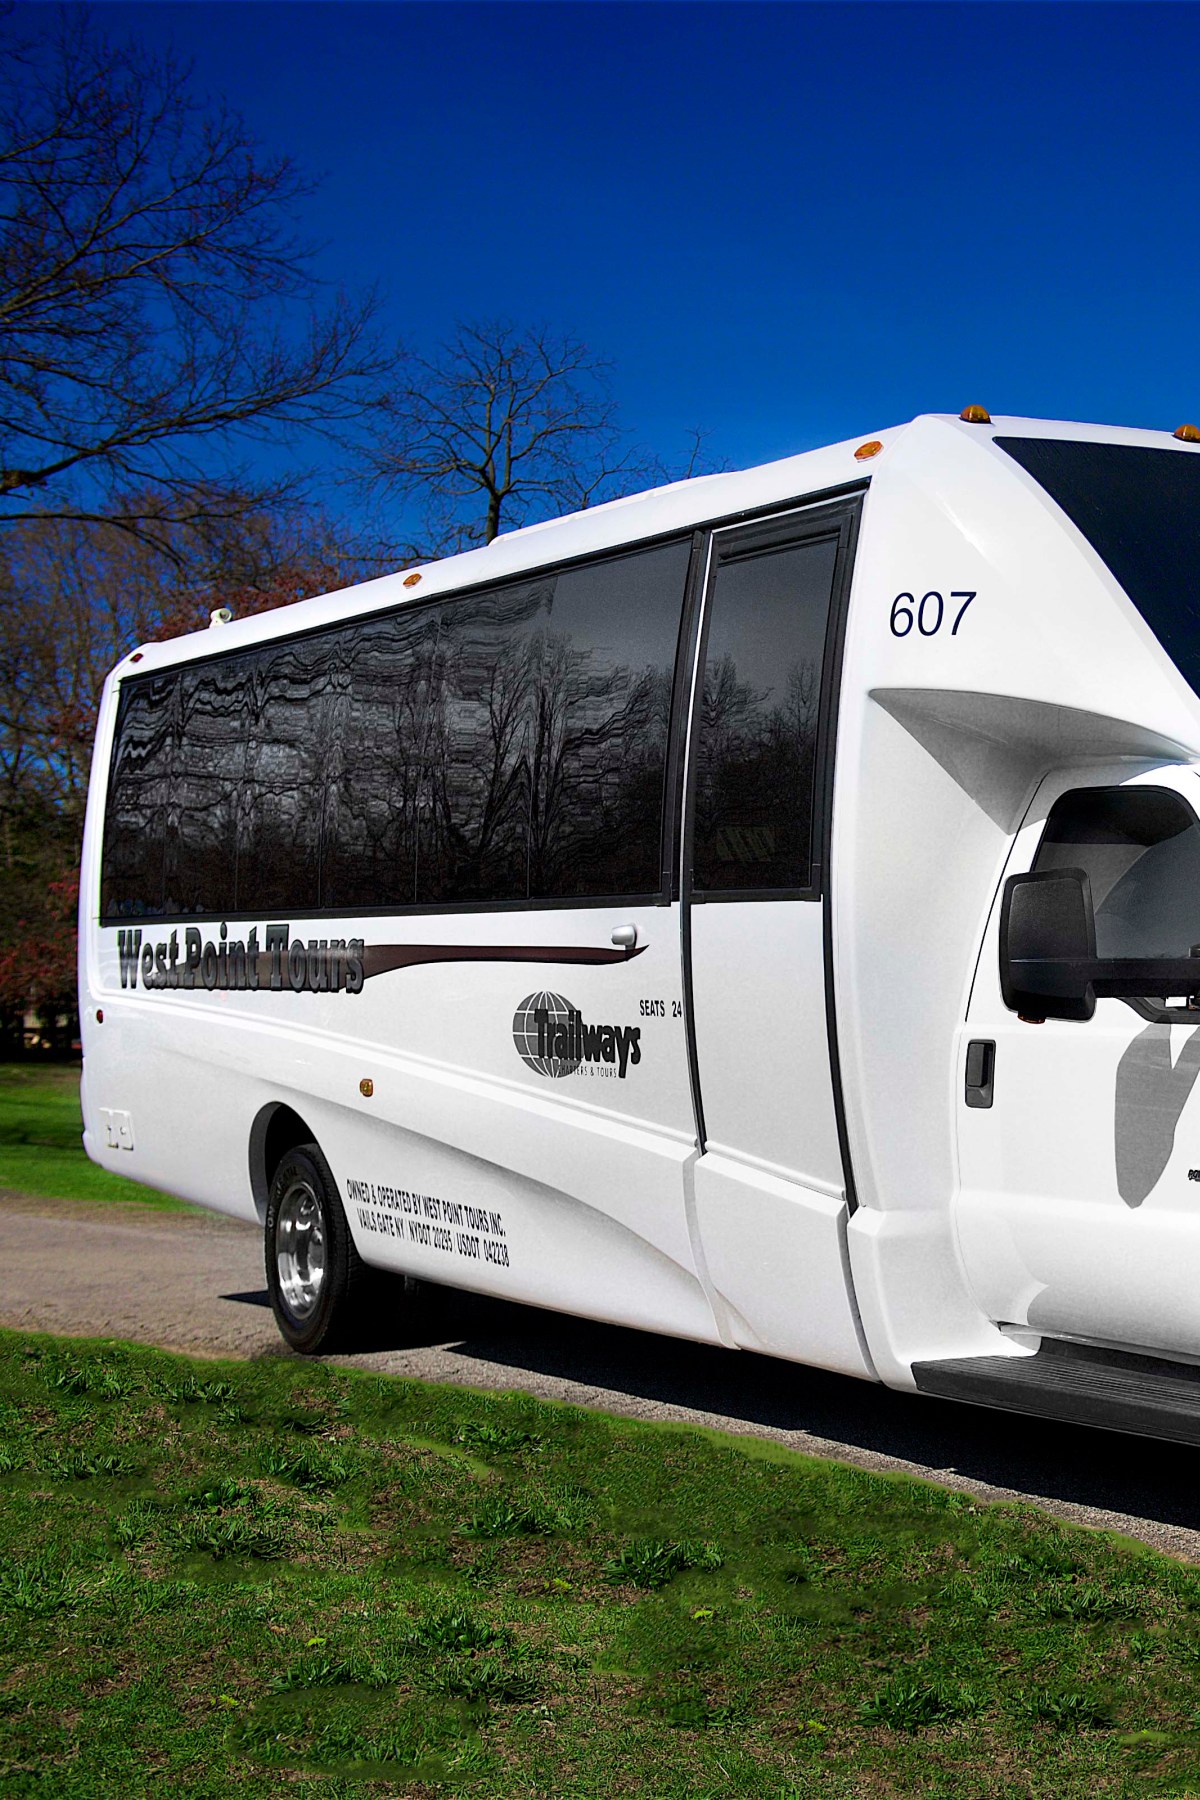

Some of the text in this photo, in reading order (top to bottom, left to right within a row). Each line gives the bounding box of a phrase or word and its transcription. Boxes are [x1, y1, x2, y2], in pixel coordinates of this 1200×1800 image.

[890, 591, 977, 638] 607
[117, 921, 364, 993] West Point Tours
[639, 1000, 682, 1017] SEATS 24
[534, 1008, 641, 1079] Trailways
[597, 1067, 617, 1078] TOURS
[347, 1179, 506, 1237] OWNED & OPERATED BY WEST POINT TOURS INC.
[357, 1208, 377, 1232] VAILS
[377, 1212, 395, 1237] GATE
[394, 1217, 405, 1239] NY
[456, 1232, 480, 1259] USDOT
